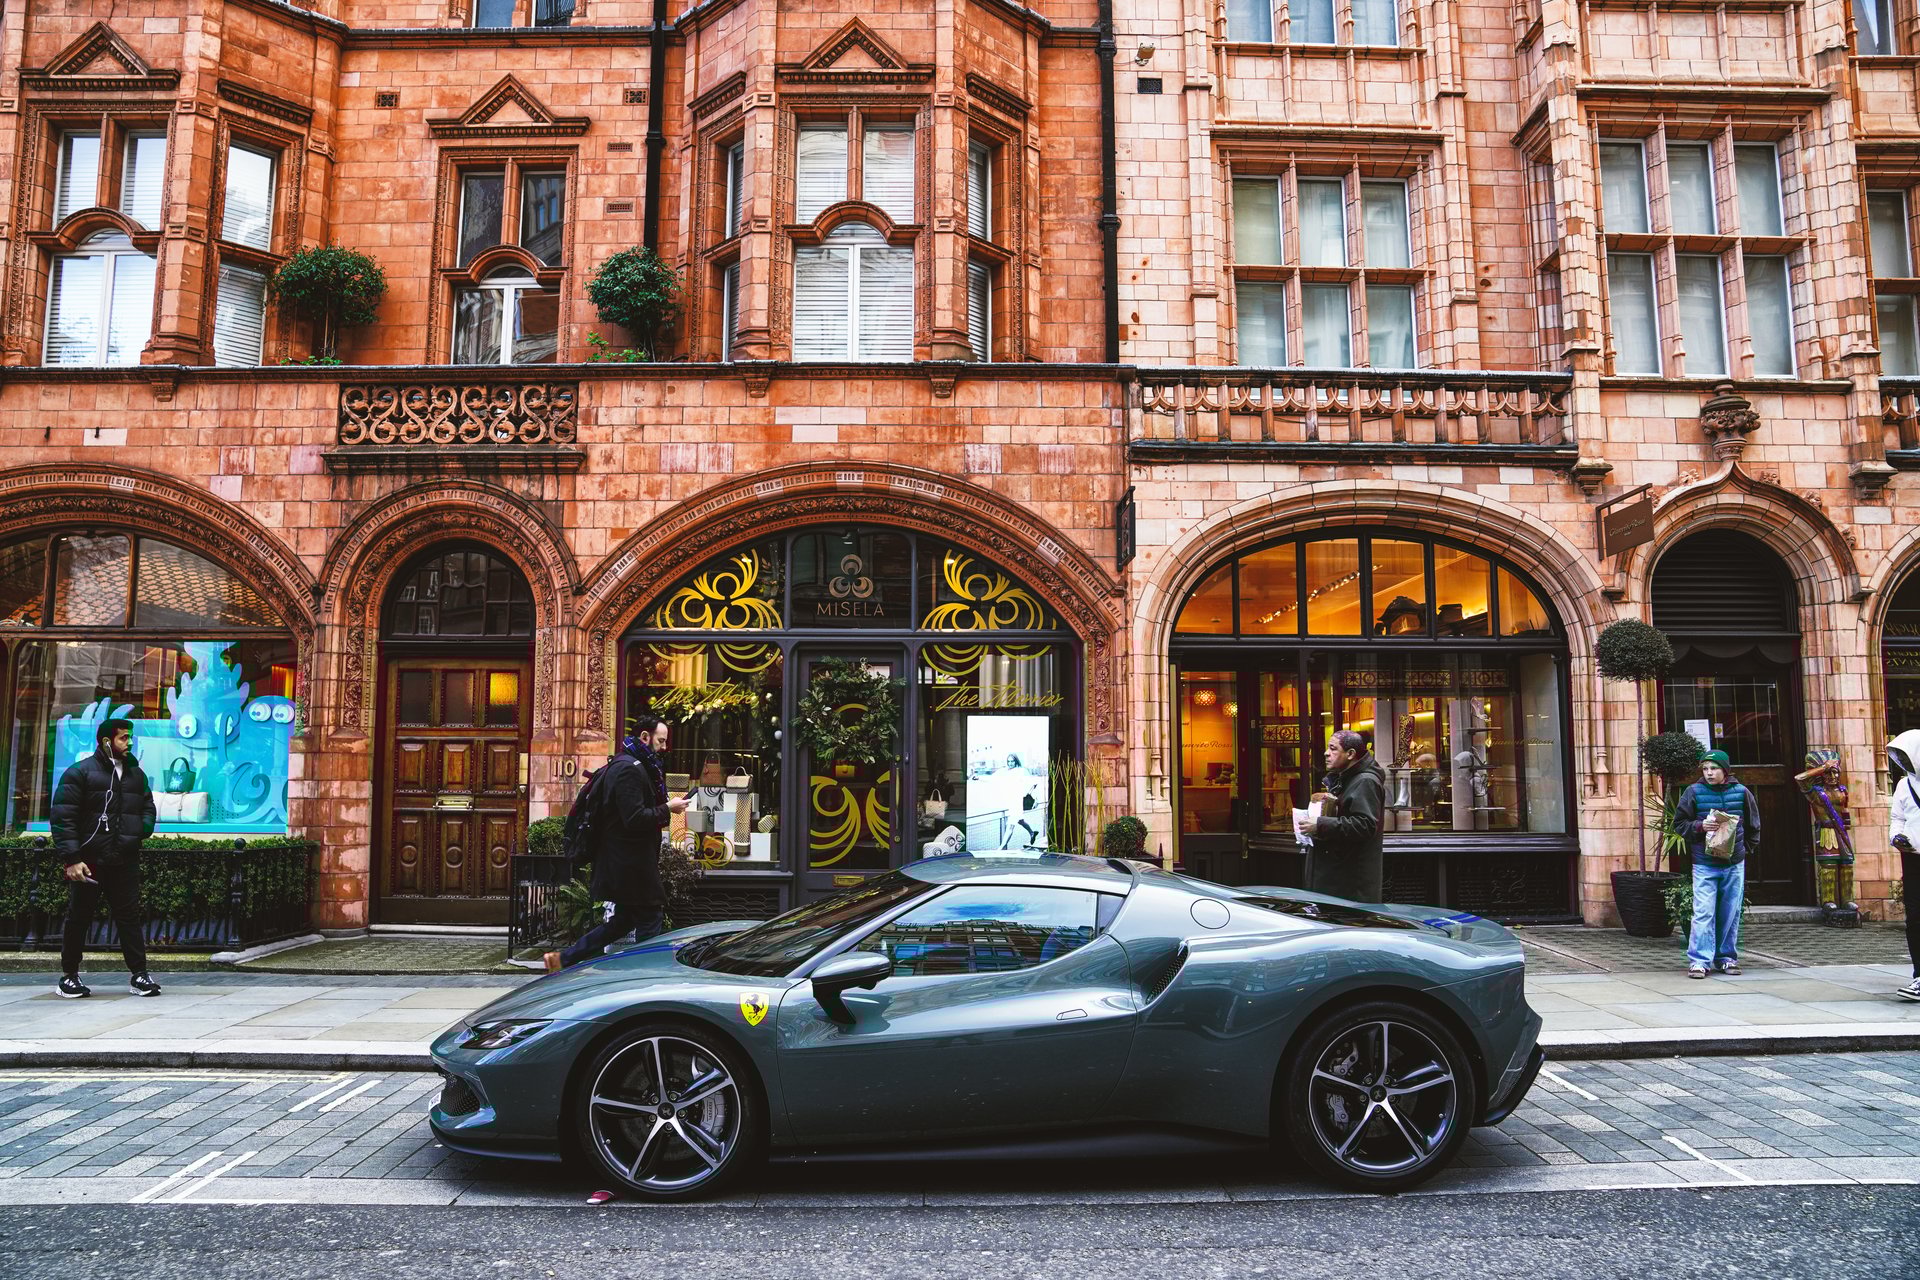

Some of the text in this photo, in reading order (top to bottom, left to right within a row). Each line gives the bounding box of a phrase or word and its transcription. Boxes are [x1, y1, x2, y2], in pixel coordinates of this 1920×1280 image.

[817, 601, 884, 617] MISELA
[932, 680, 1064, 711] The Merrier
[553, 760, 576, 777] 110
